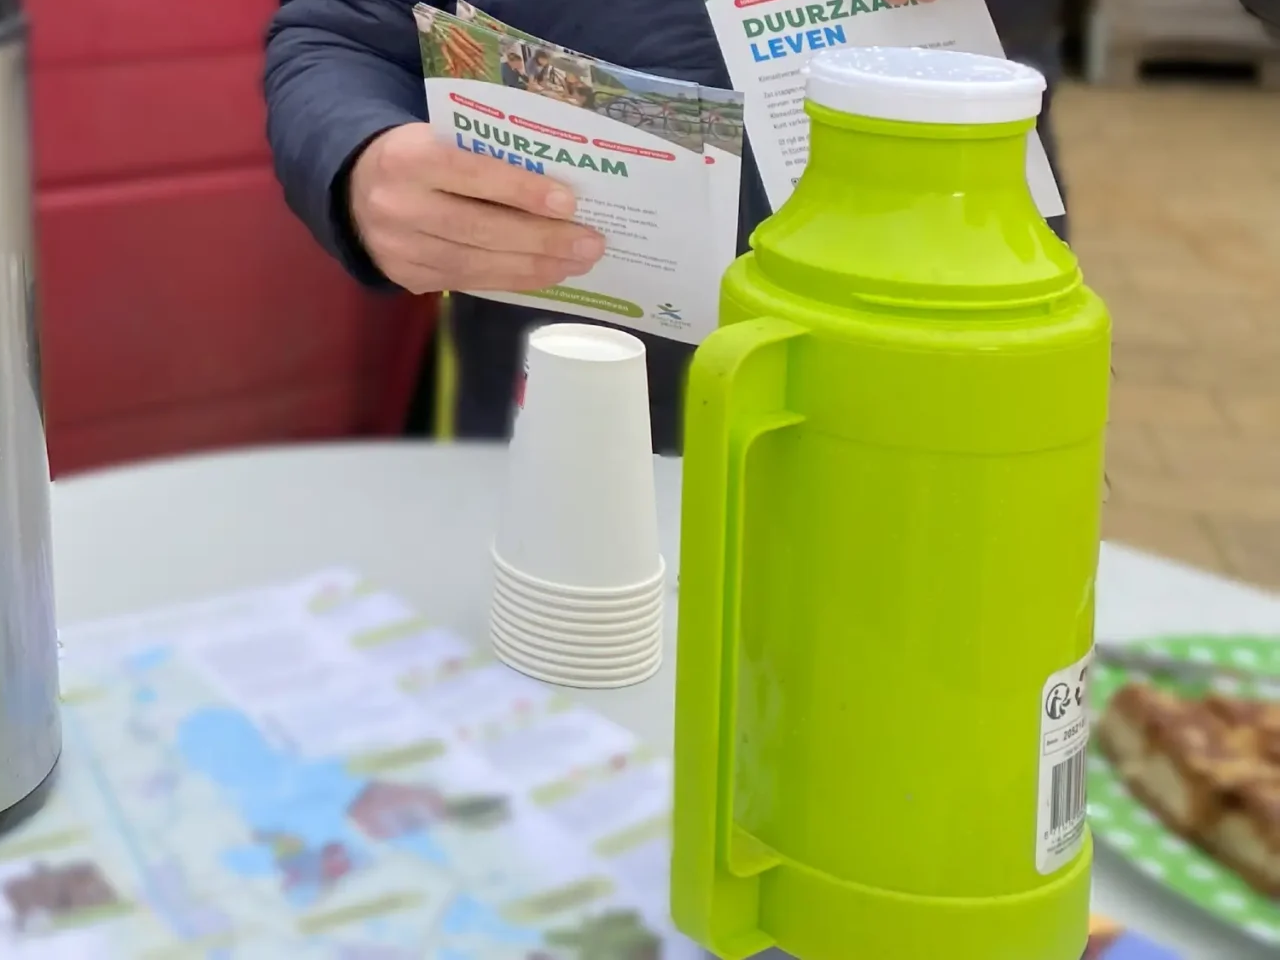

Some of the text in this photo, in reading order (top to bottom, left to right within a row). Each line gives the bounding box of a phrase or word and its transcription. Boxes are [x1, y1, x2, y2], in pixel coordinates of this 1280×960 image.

[750, 24, 847, 63] LEVEN
[453, 111, 629, 178] DUURZAAM
[456, 131, 545, 175] LEVEN
